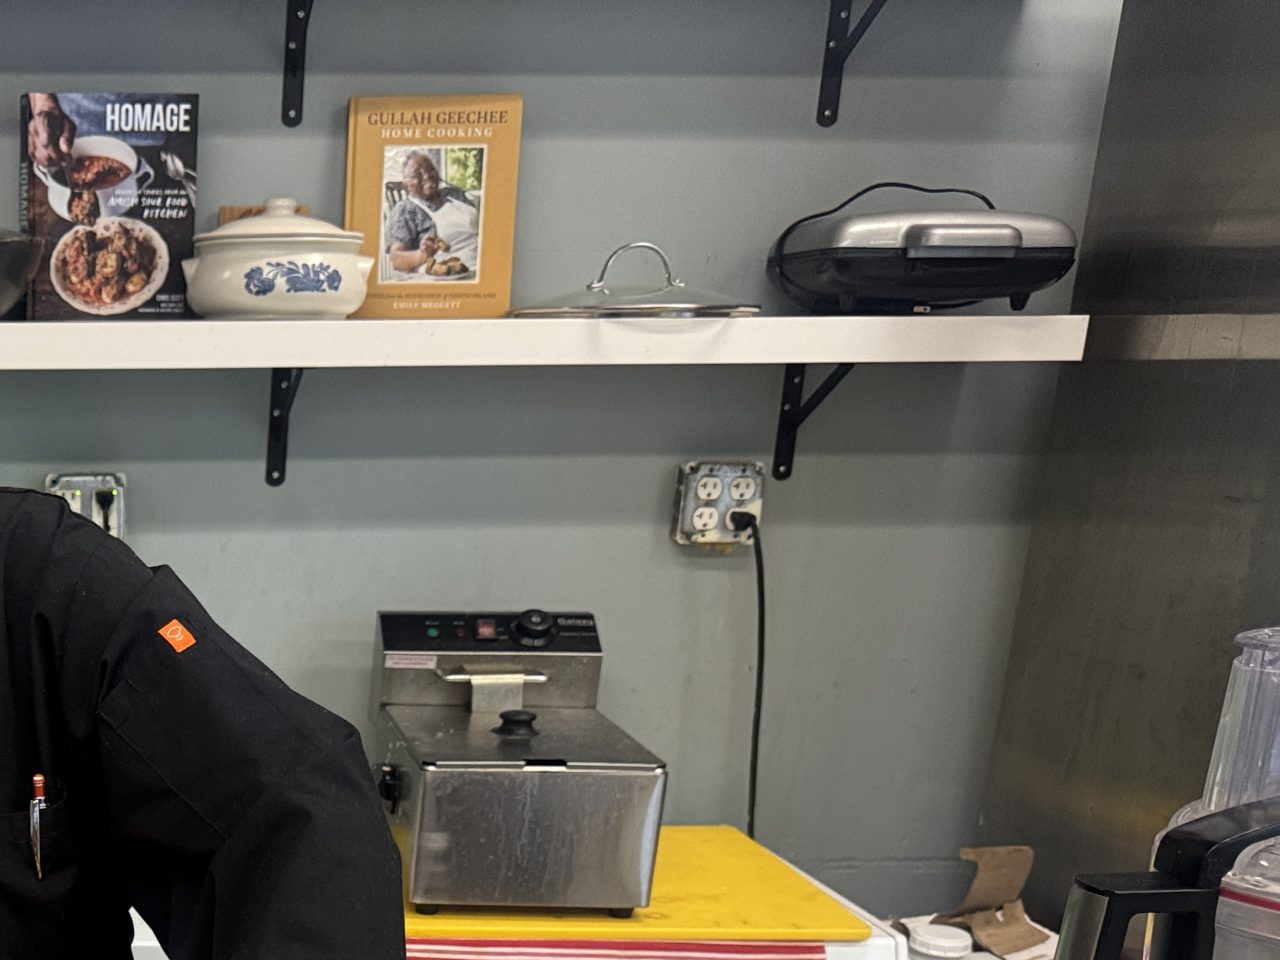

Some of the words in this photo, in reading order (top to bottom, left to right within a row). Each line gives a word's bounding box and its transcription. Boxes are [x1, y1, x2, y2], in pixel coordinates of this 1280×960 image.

[105, 103, 192, 132] HOMAGE
[367, 111, 432, 126] GULLAH
[436, 110, 508, 125] GEECHEE
[380, 128, 422, 139] HOME
[427, 127, 493, 138] COOKING
[143, 208, 189, 219] KITCHEN
